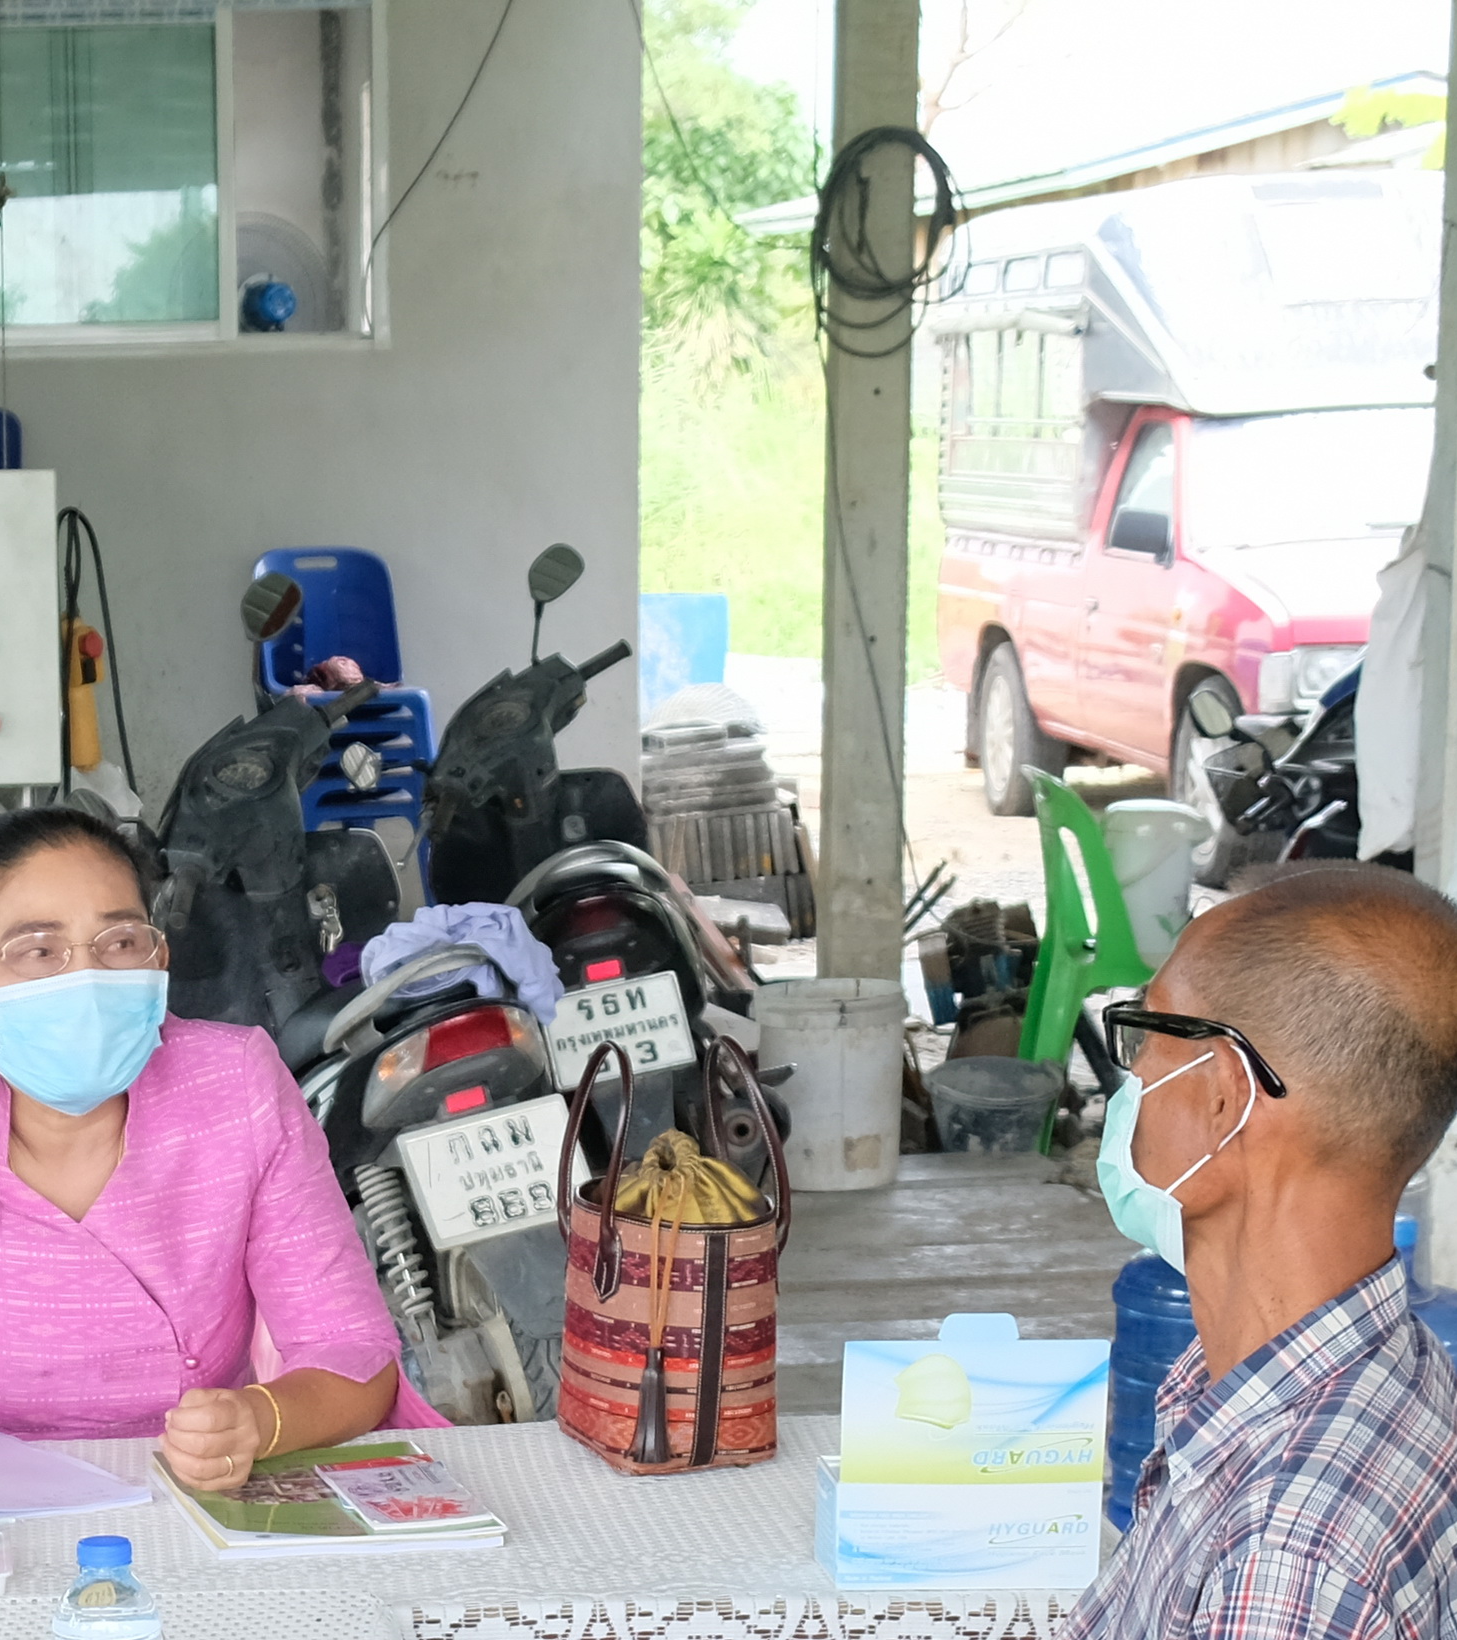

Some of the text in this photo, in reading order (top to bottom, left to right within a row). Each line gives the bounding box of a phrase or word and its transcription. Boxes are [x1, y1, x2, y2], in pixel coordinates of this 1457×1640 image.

[556, 1013, 679, 1054] กรุงเทพมหานคร
[972, 1449, 1093, 1466] HYGUARD
[988, 1521, 1089, 1536] HYGUARD
